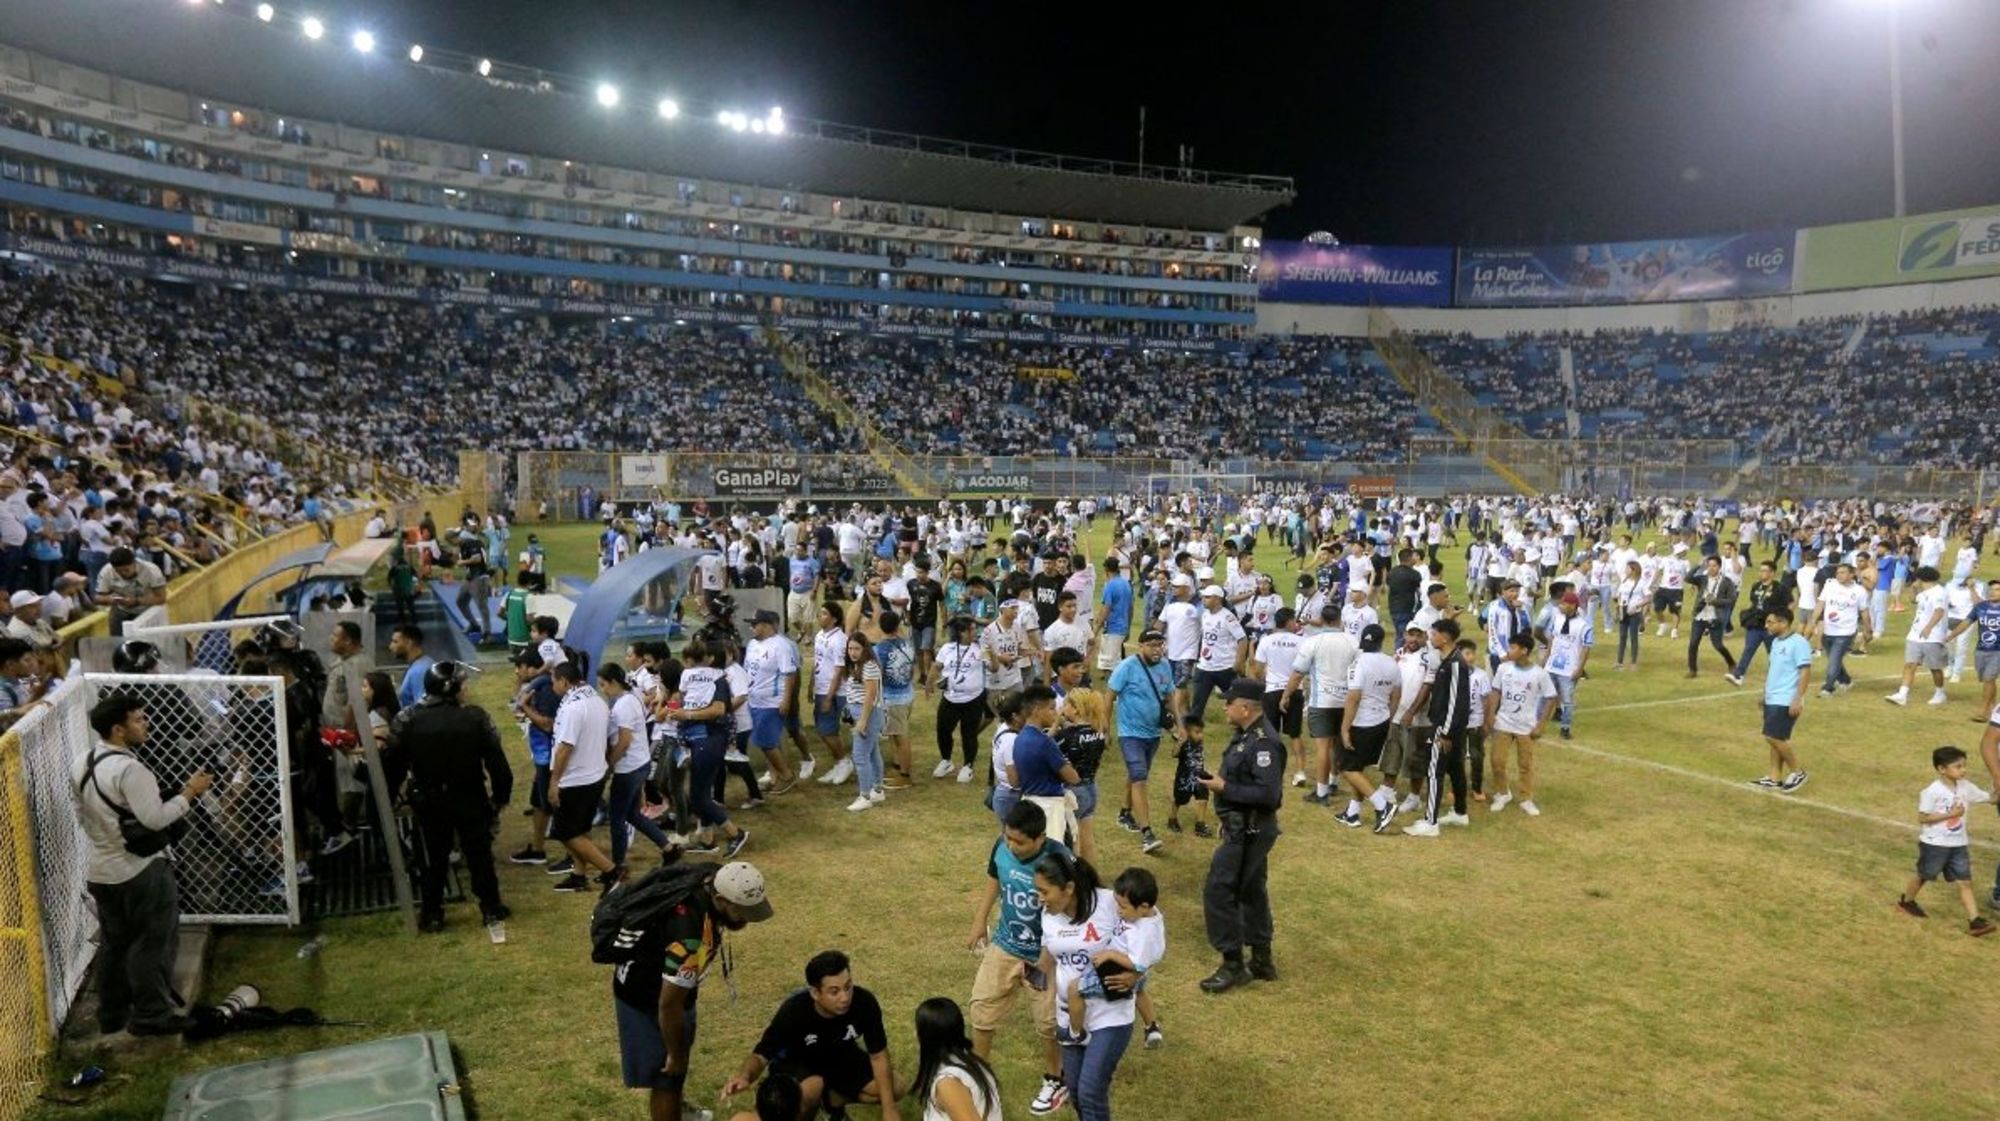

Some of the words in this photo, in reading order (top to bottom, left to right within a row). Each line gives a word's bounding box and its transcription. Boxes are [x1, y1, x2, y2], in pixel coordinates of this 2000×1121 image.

[1285, 263, 1439, 287] SHERWIN-WILLIAMS
[1475, 266, 1493, 281] La
[1496, 265, 1526, 281] Red
[1508, 282, 1550, 298] Goles
[715, 469, 801, 487] GanaPlay
[968, 476, 1028, 487] ACODJAR
[1083, 922, 1100, 942] A
